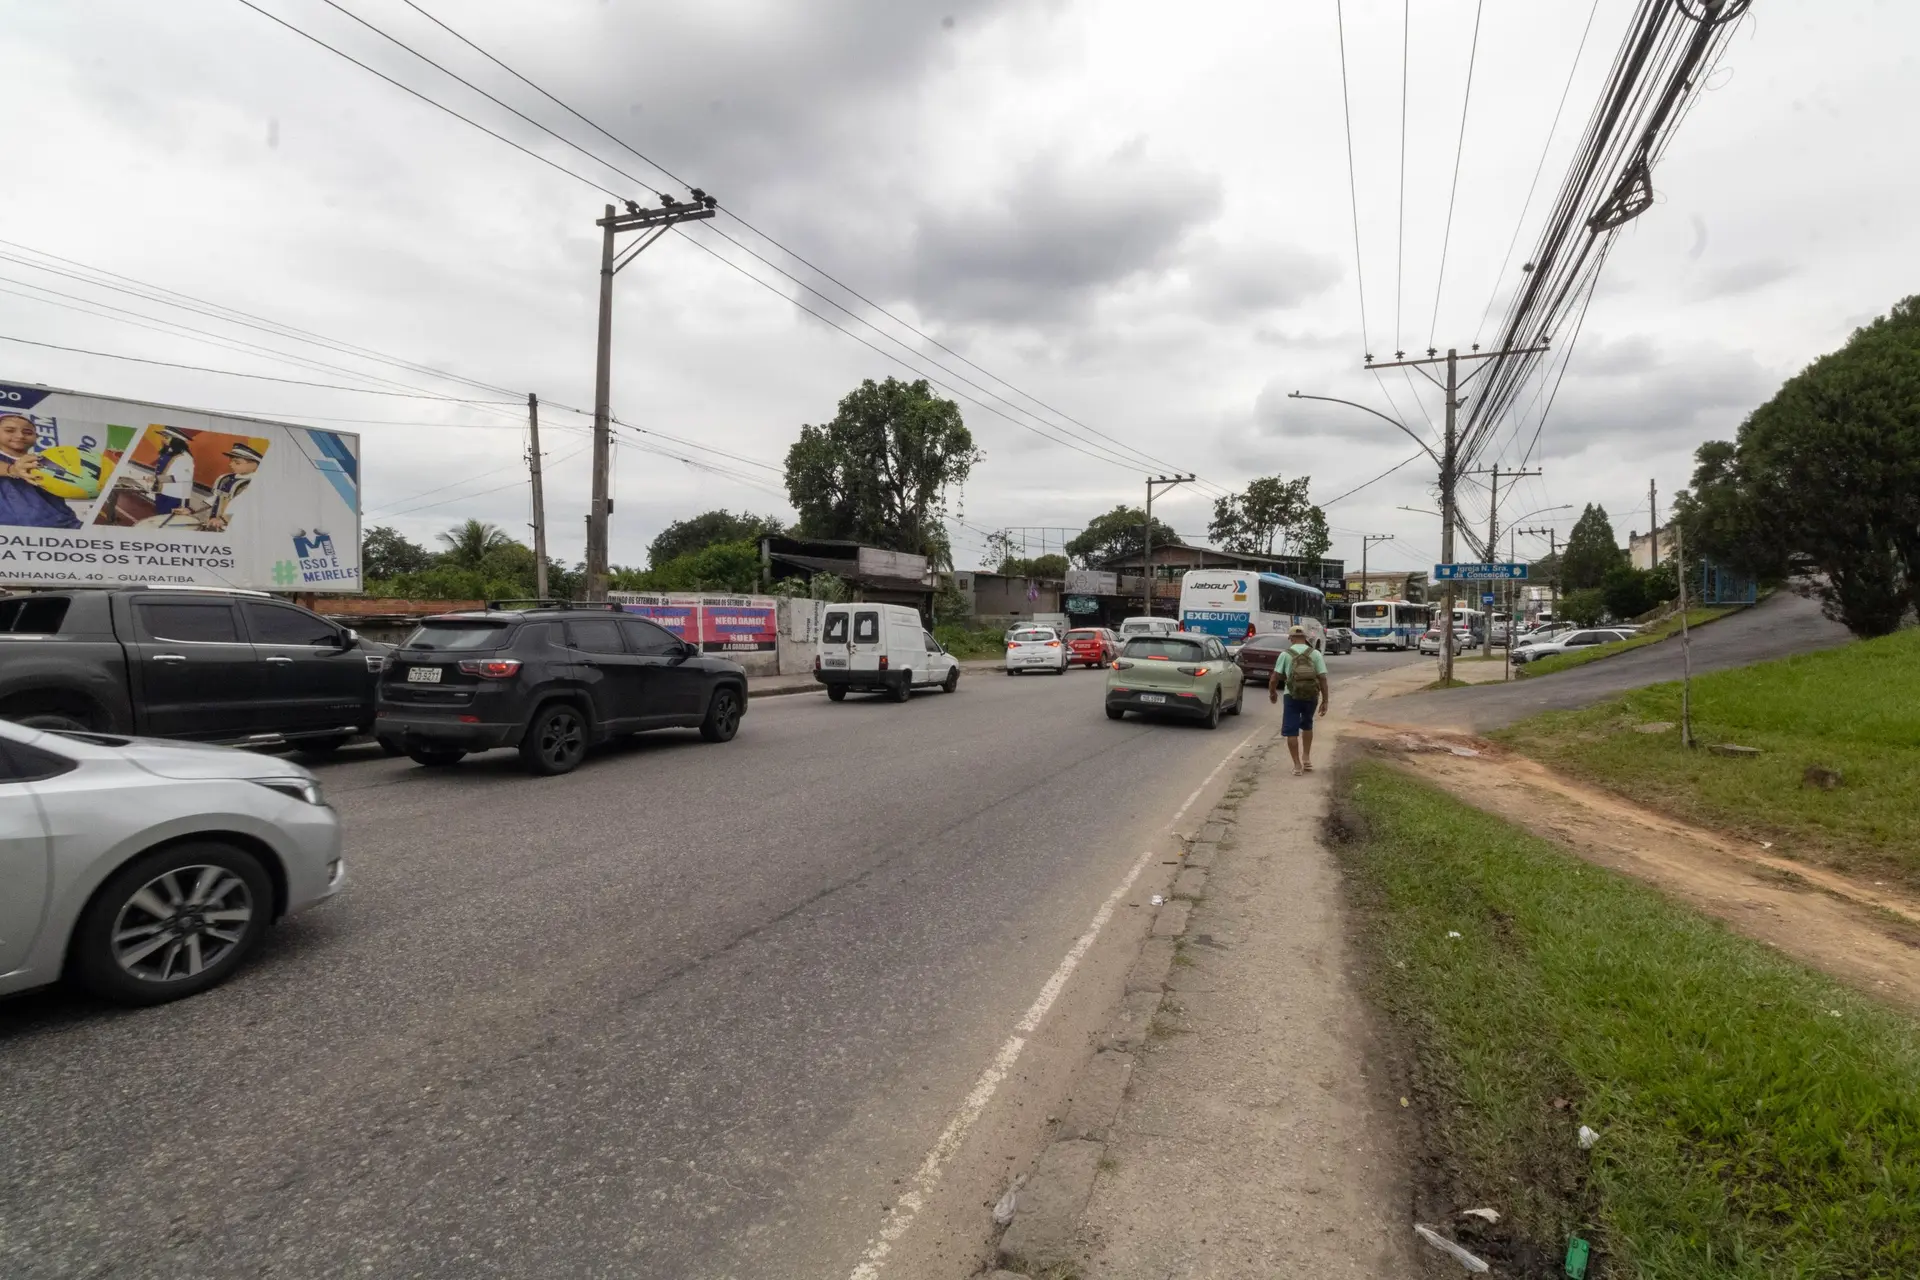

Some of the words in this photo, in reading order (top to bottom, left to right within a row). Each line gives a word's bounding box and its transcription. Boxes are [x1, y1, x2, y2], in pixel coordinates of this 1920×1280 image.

[120, 541, 232, 556] ESPORTIVAS
[22, 551, 97, 563] TODOS
[102, 554, 129, 565] OS
[135, 556, 235, 568] TALENTOS!
[300, 558, 327, 570] ISSO
[331, 555, 339, 567] É
[1457, 565, 1479, 573] Igreja
[85, 573, 104, 581] 40
[118, 573, 195, 583] GUARATIBA
[303, 567, 359, 582] MEIRELES
[1467, 571, 1510, 579] Conceição
[1190, 582, 1232, 590] Jabour
[715, 616, 736, 625] NEGO
[1186, 612, 1247, 621] EXECUTIVO
